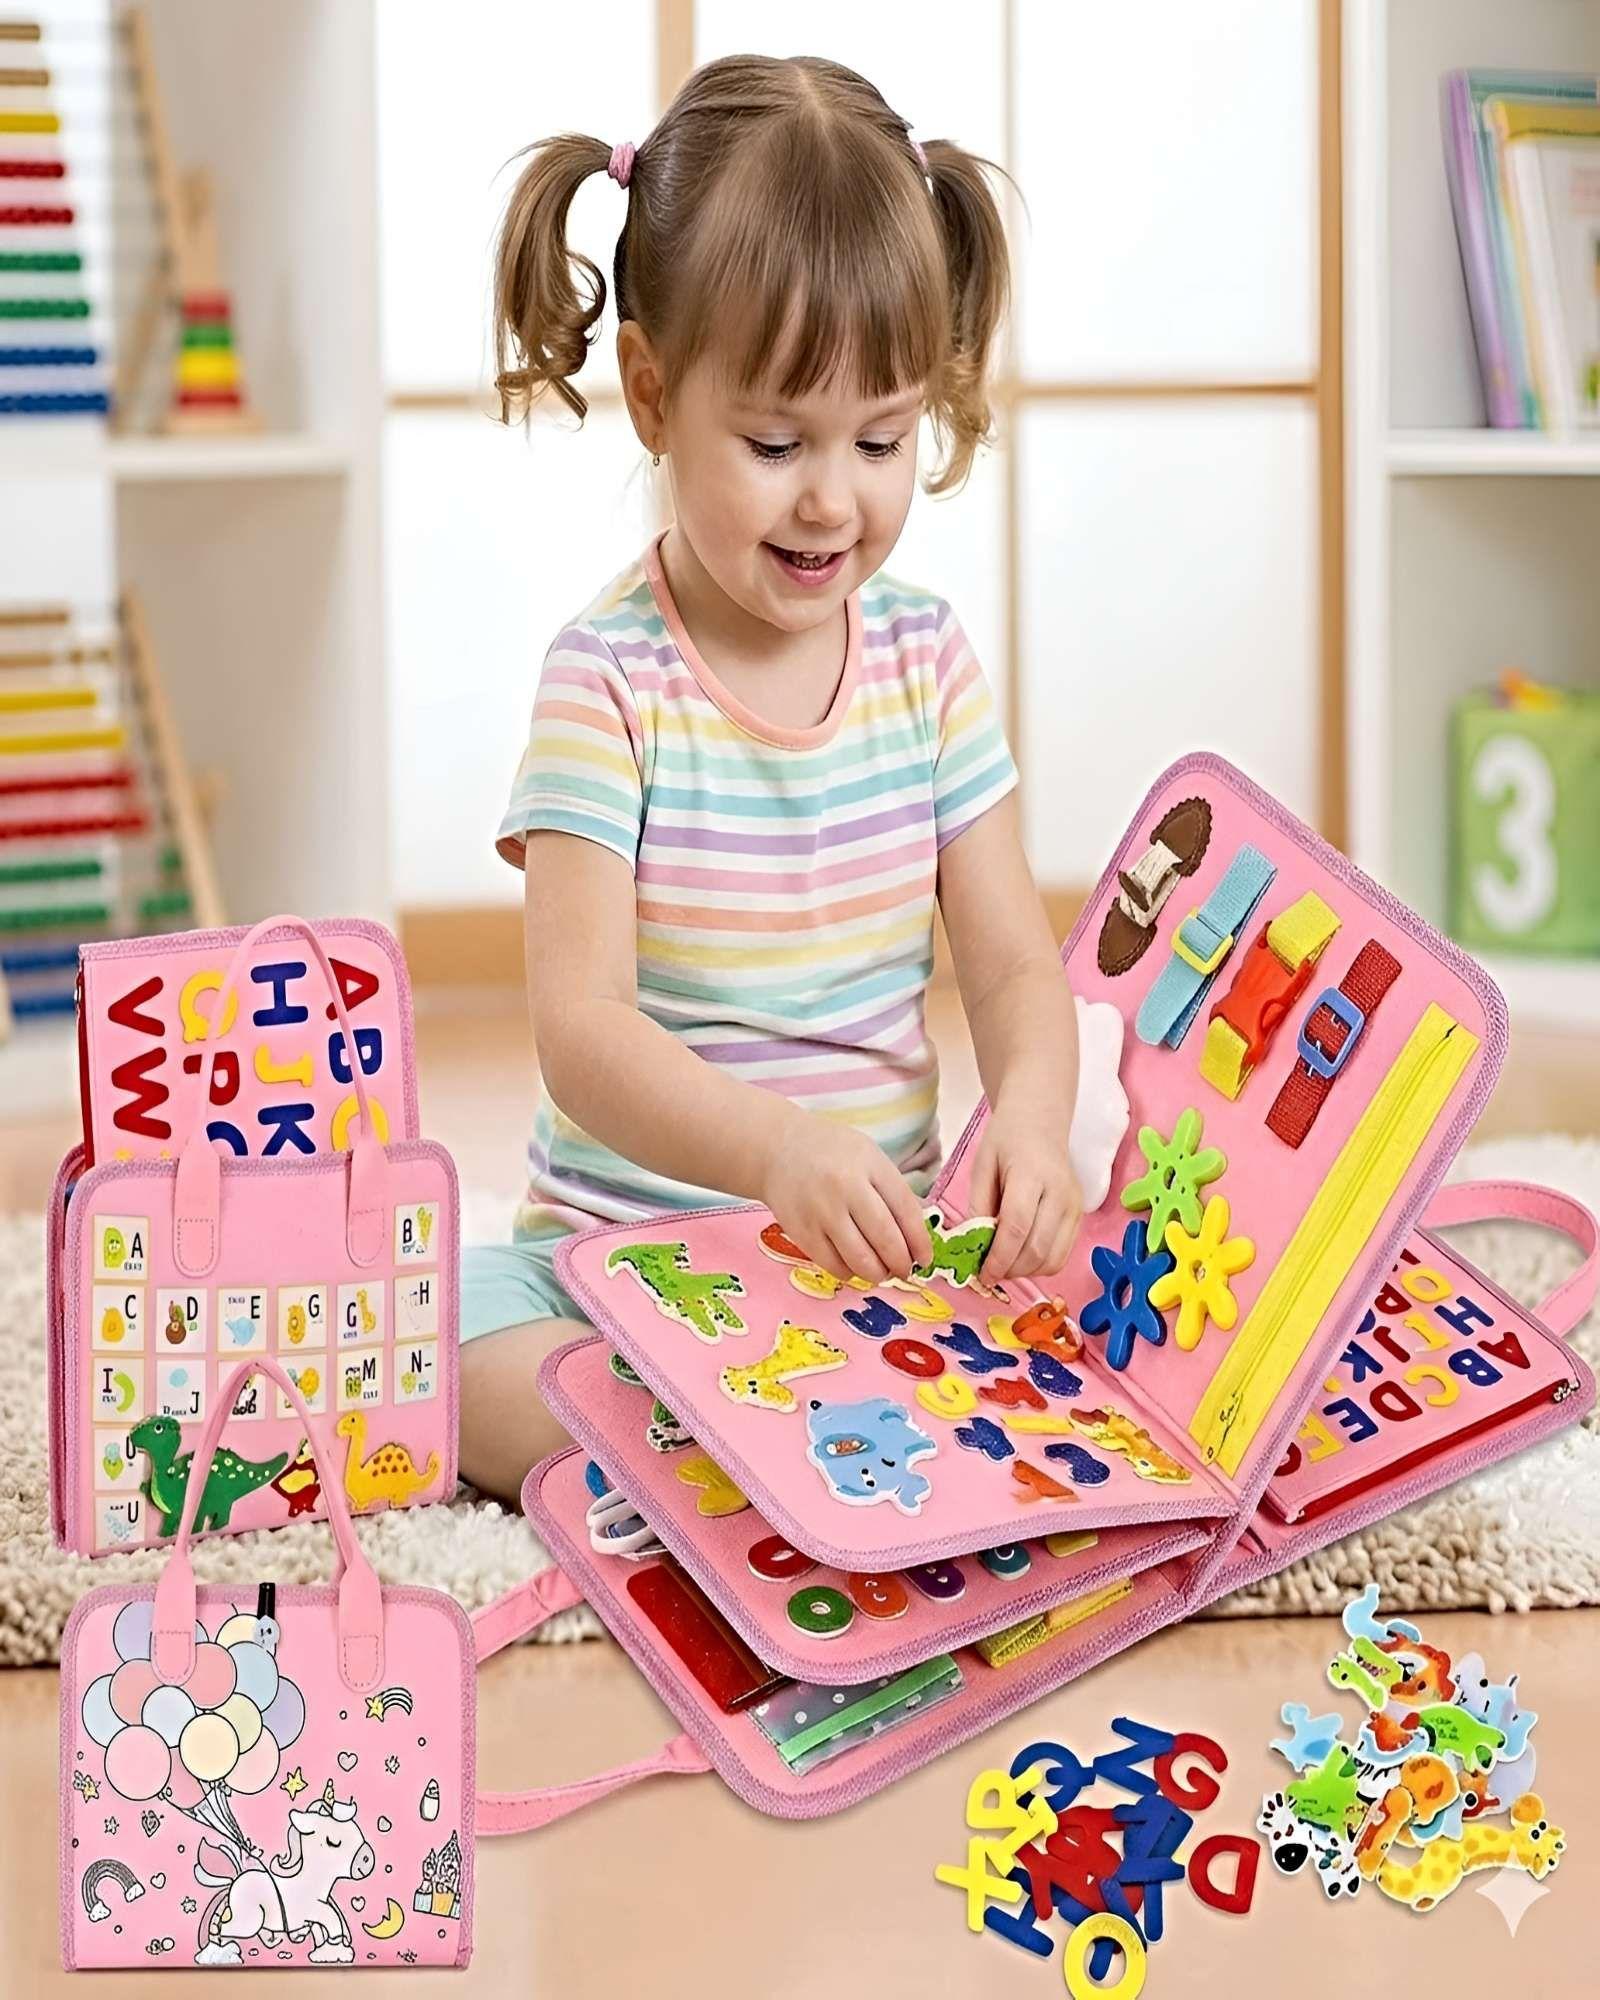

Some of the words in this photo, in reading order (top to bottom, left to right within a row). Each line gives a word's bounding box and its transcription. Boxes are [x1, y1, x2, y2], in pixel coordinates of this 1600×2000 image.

[1468, 730, 1558, 934] 3
[108, 975, 166, 1037] V
[325, 957, 380, 1021] A
[257, 1102, 317, 1157] K
[131, 1232, 144, 1259] A
[402, 1218, 413, 1244] B
[125, 1294, 137, 1320] C
[186, 1296, 199, 1321] D
[250, 1295, 261, 1320] E
[308, 1293, 320, 1319] G
[1434, 1295, 1496, 1337] H
[1447, 1348, 1504, 1387] B
[1477, 1331, 1532, 1370] A
[102, 1367, 114, 1394] I
[1403, 1364, 1461, 1408] C
[189, 1391, 200, 1415] J
[1322, 1397, 1380, 1443] E
[1369, 1380, 1424, 1422] D
[127, 1500, 139, 1524] U
[1152, 1731, 1230, 1812] G
[1188, 1834, 1262, 1915] D
